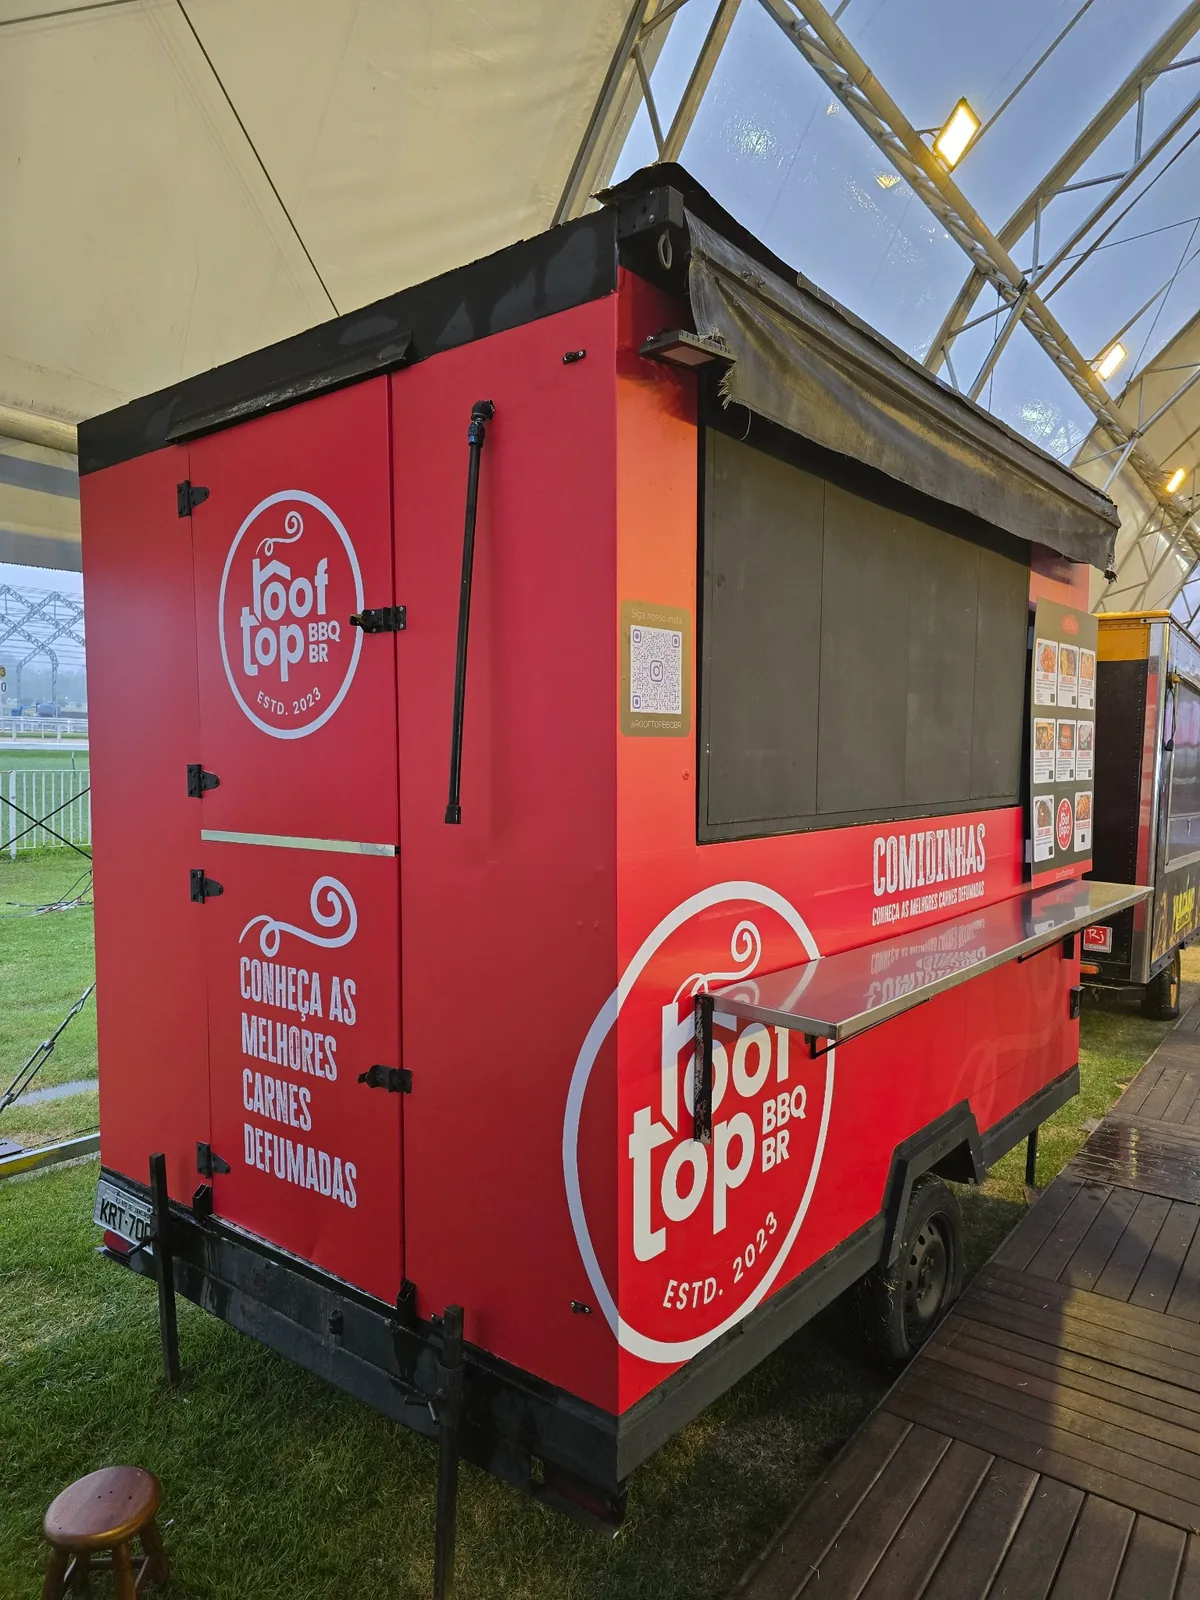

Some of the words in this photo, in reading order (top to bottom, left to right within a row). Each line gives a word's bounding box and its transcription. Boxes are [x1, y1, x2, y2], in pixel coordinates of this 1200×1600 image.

[252, 557, 328, 622] roof
[631, 608, 646, 621] Siga
[240, 606, 304, 682] top
[308, 620, 341, 642] BBQ
[308, 644, 329, 663] BR
[256, 691, 288, 716] ESTD.
[293, 686, 322, 715] 2023
[873, 823, 986, 897] COMIDINHAS
[872, 902, 900, 926] CONHEÇA
[901, 900, 909, 919] AS
[909, 893, 938, 917] MELHORES
[938, 887, 958, 909] CARNES
[240, 956, 323, 1022] CONHEÇA
[329, 976, 357, 1026] AS
[241, 1012, 337, 1082] MELHORES
[242, 1068, 312, 1132] CARNES
[244, 1123, 357, 1209] DEFUMADAS
[628, 1106, 755, 1263] top
[762, 1085, 807, 1136] BBQ
[761, 1129, 790, 1174] BR
[662, 1279, 724, 1311] ESTD.
[733, 1210, 779, 1284] 2023
